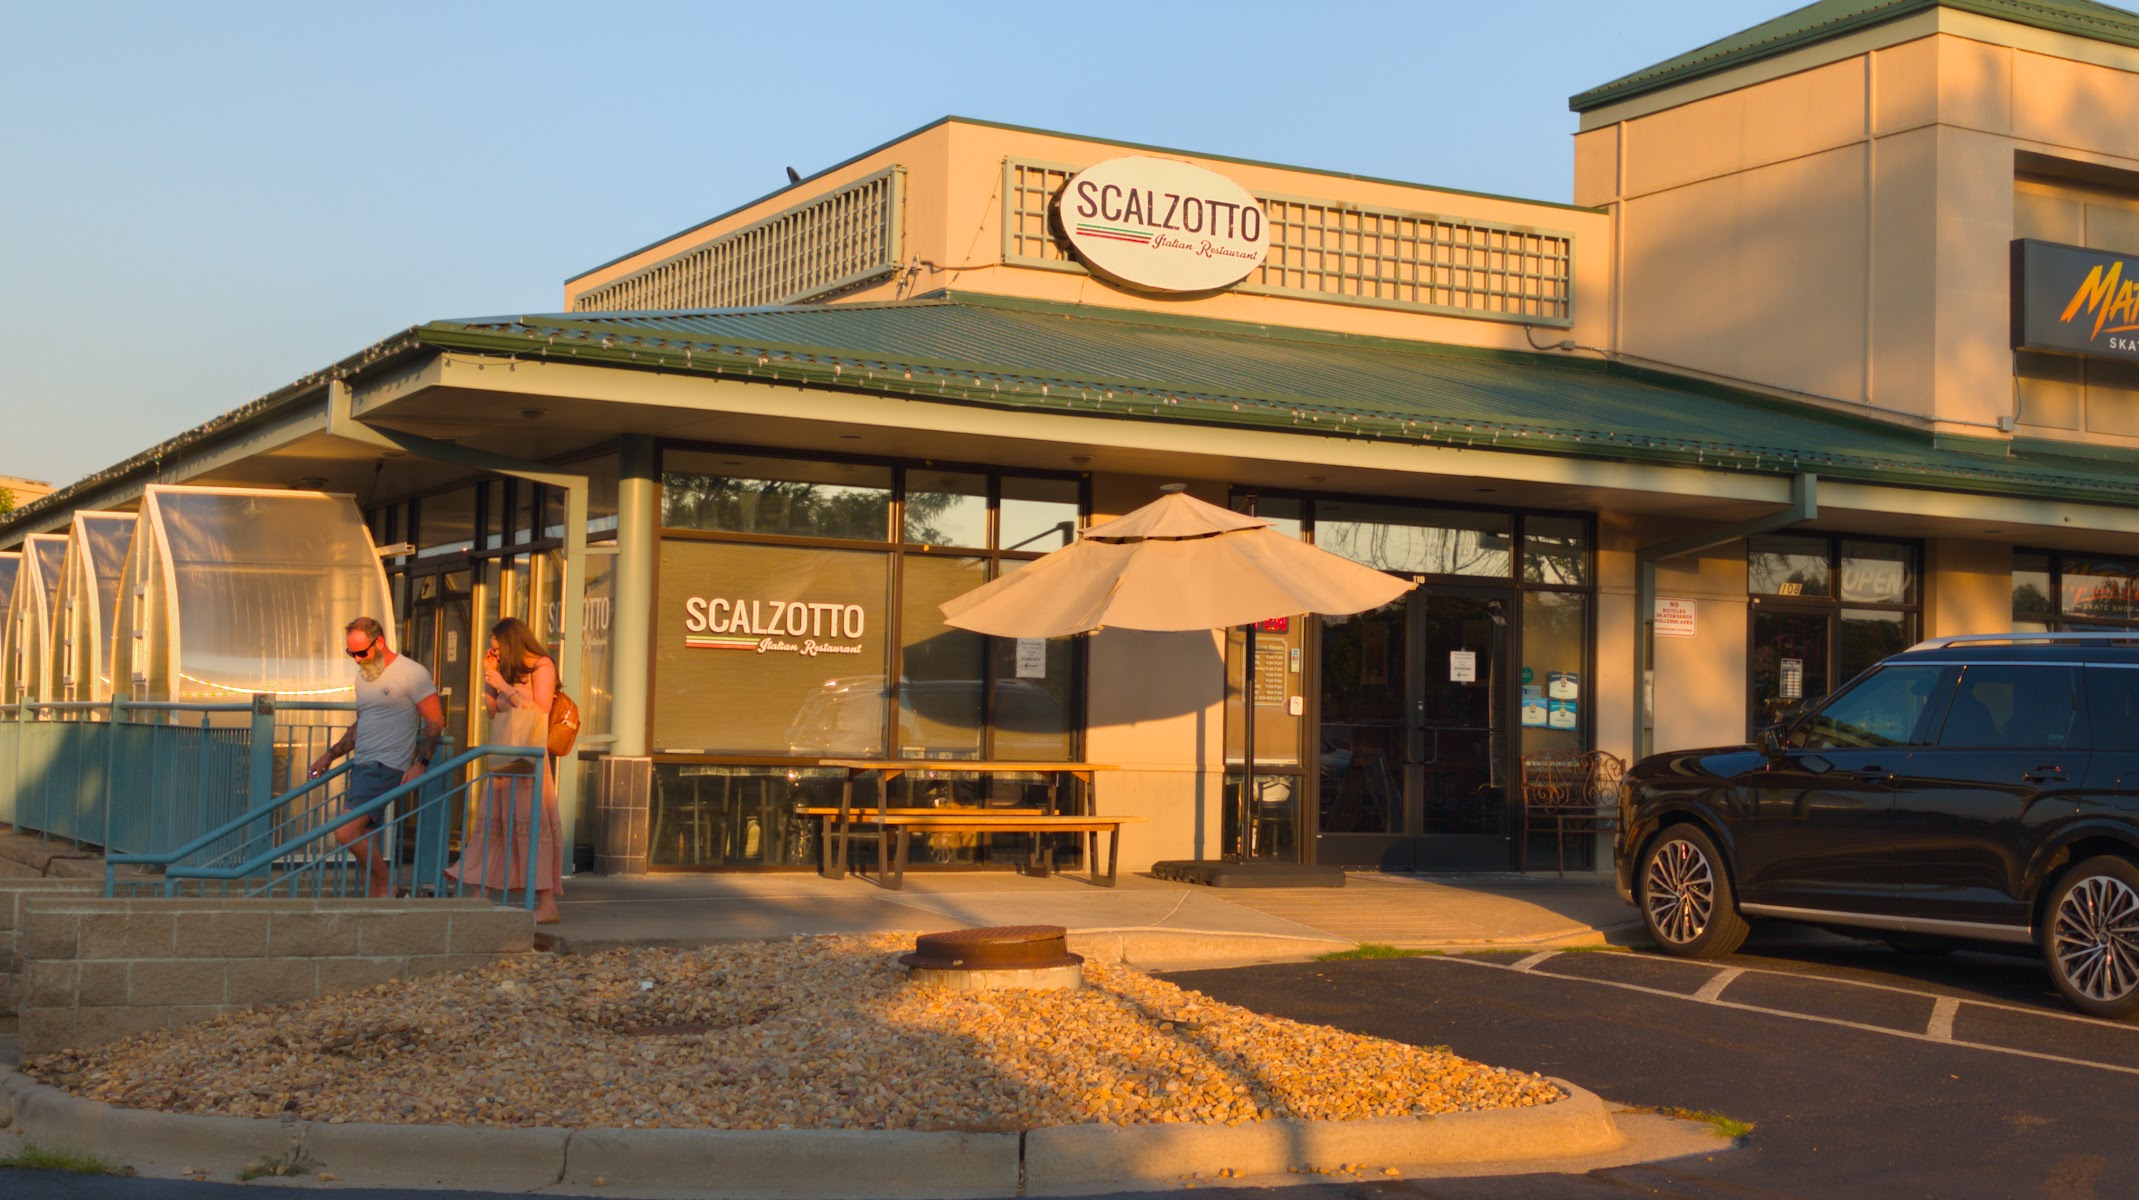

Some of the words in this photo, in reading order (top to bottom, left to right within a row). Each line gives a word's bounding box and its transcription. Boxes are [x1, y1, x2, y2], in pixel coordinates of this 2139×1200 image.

[1077, 180, 1260, 242] SCALZOTTO
[1152, 233, 1193, 250] Italian
[1196, 240, 1258, 260] Restaurant
[2109, 337, 2139, 352] SKA
[1412, 575, 1425, 584] 110
[1781, 583, 1800, 595] 108
[1842, 566, 1906, 596] OPEN
[686, 597, 865, 638] SCALZOTTO
[2112, 605, 2134, 613] SHOP
[757, 638, 799, 653] Italian
[800, 639, 862, 657] Restaurant
